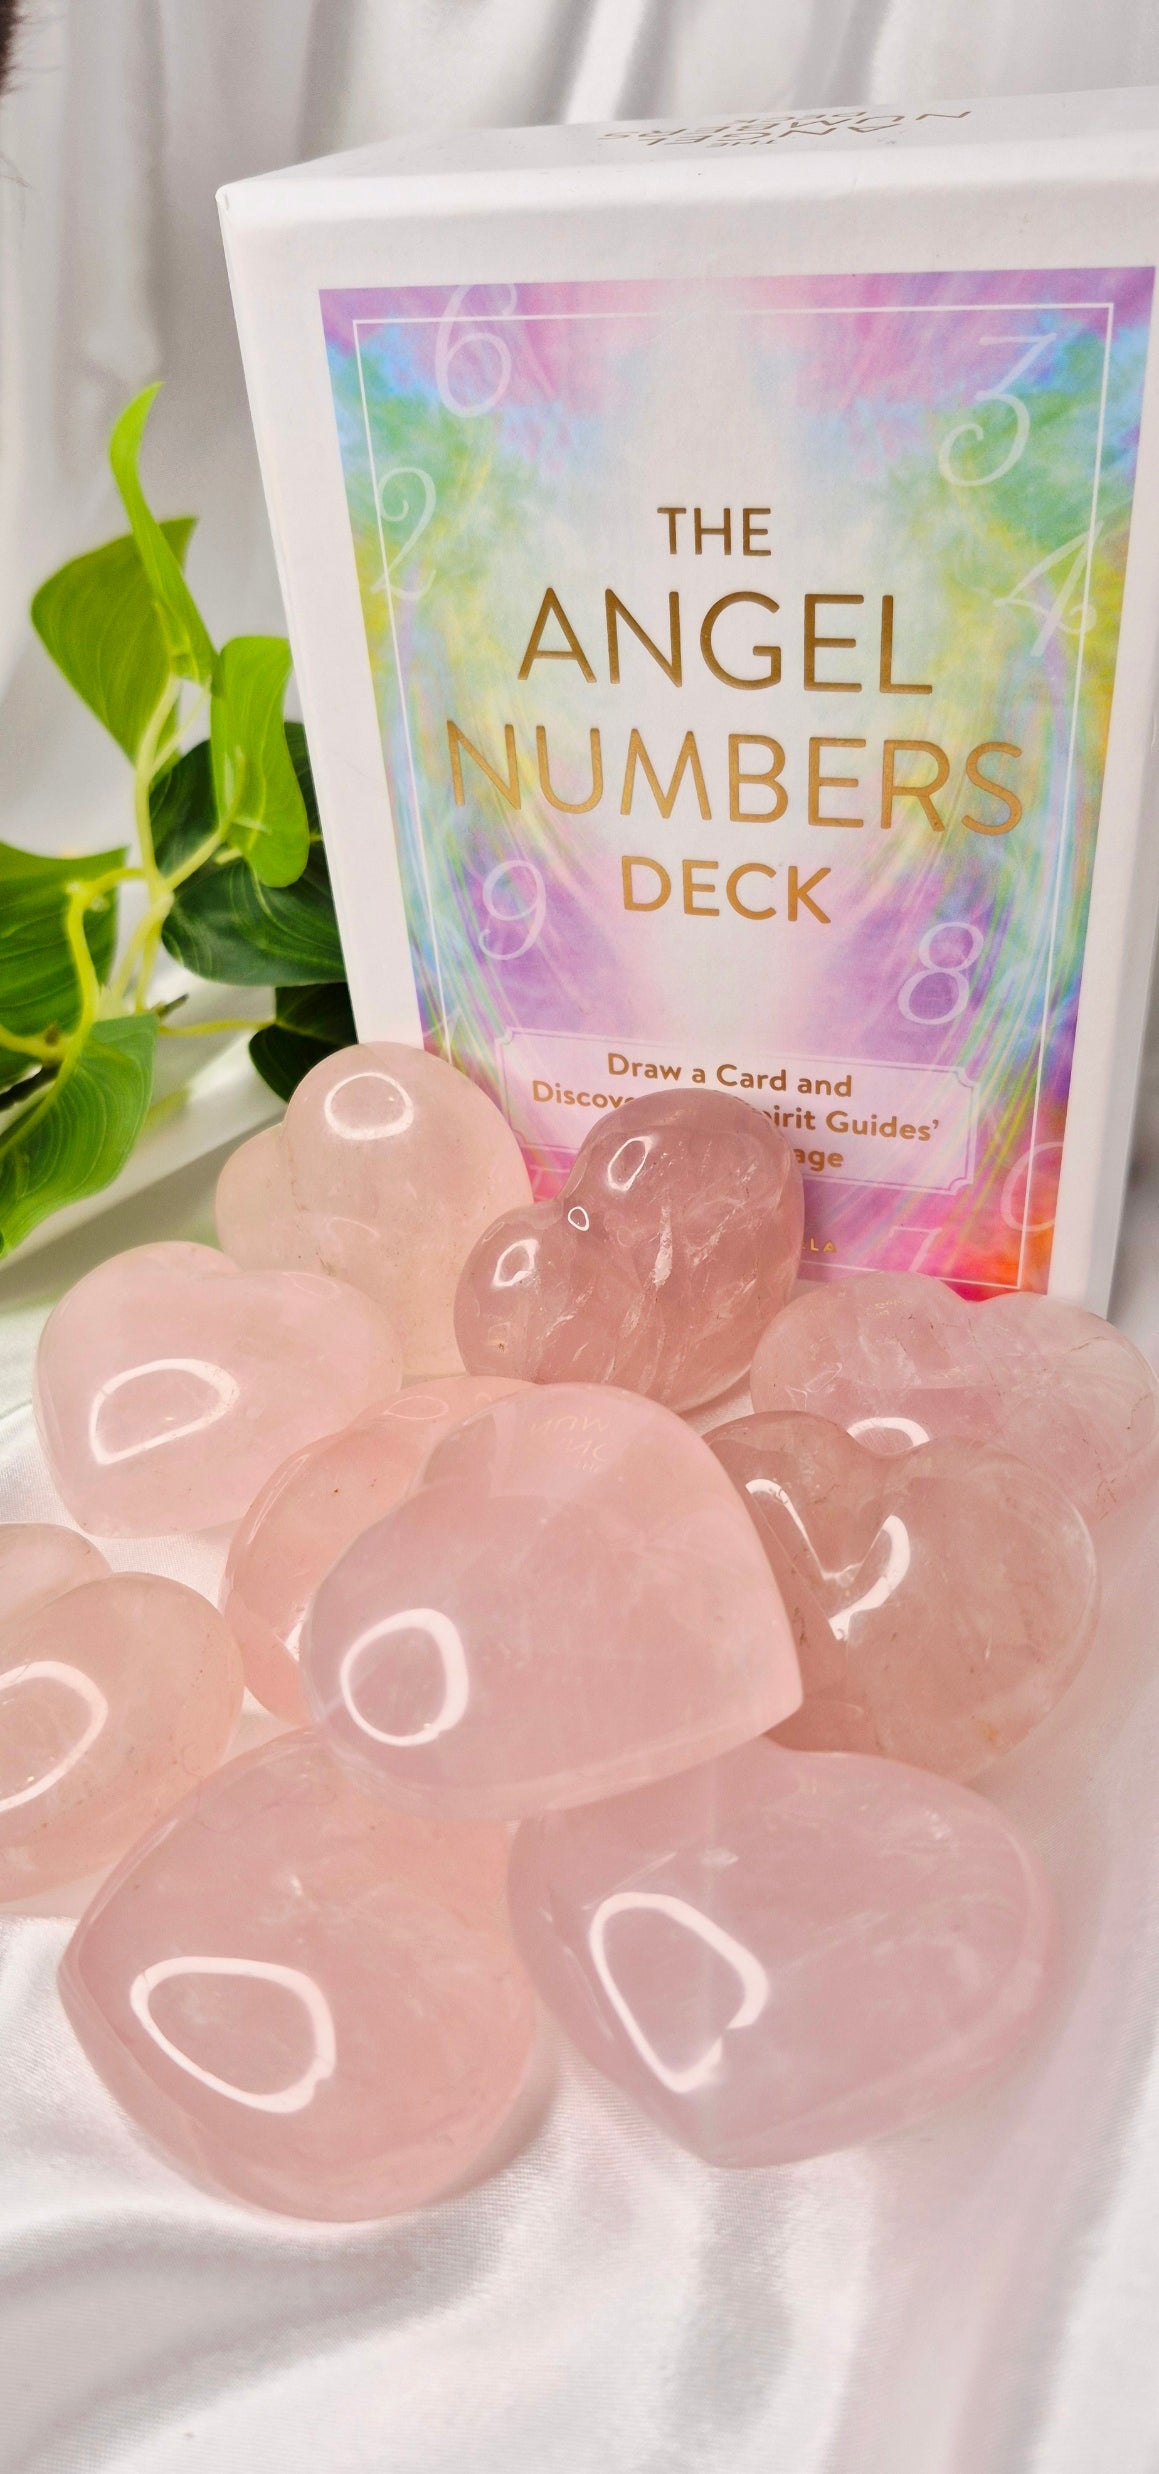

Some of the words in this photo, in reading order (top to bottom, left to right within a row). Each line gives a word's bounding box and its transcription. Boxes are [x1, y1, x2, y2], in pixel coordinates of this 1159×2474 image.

[599, 111, 972, 140] NUMBERS
[647, 124, 901, 146] ANGEL
[434, 283, 518, 419] 6
[937, 331, 1057, 487] 3
[370, 466, 437, 602] 2
[656, 506, 772, 558] THE
[992, 517, 1105, 659] 4
[517, 586, 934, 696] ANGEL
[446, 719, 1024, 837] NUMBERS
[478, 859, 547, 961] 9
[620, 855, 833, 925] DECK
[900, 920, 985, 1026] 8
[532, 1079, 635, 1109] Discov
[607, 1052, 683, 1082] Draw
[691, 1067, 707, 1084] a
[716, 1063, 788, 1092] Card
[797, 1074, 853, 1098] and
